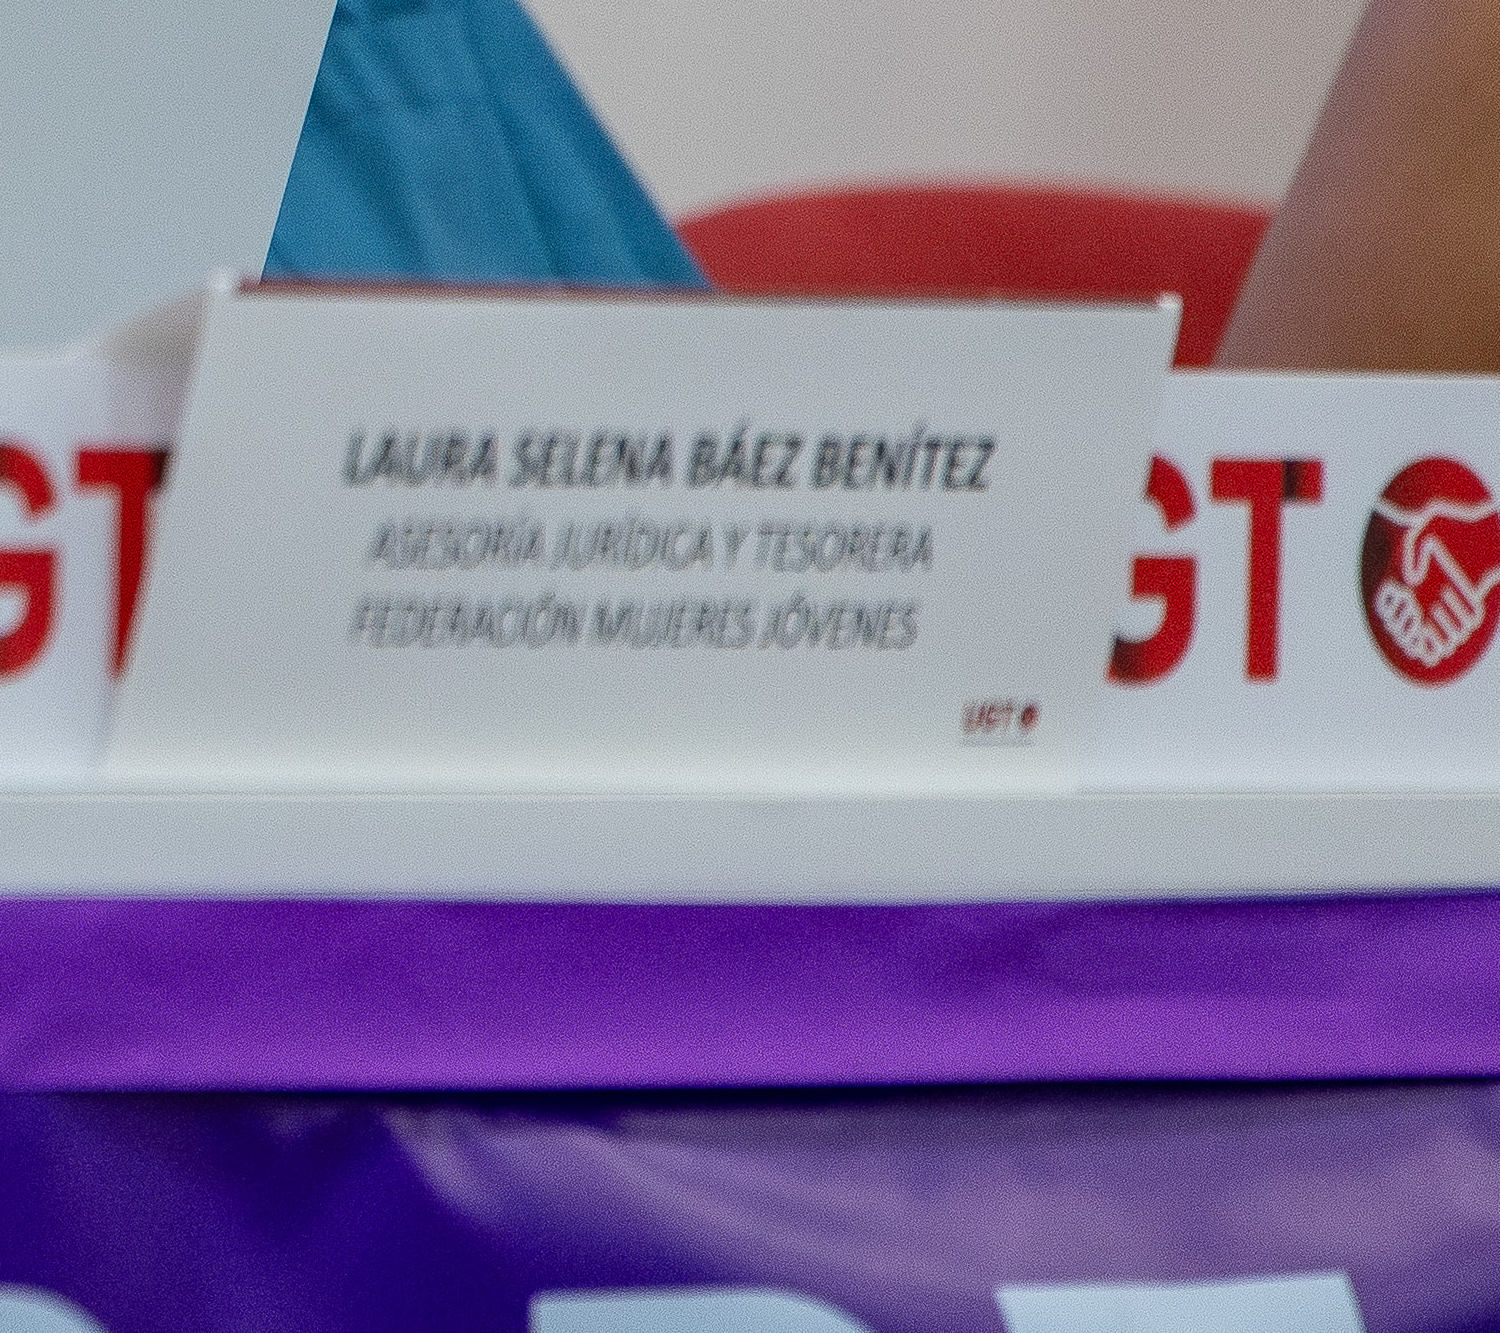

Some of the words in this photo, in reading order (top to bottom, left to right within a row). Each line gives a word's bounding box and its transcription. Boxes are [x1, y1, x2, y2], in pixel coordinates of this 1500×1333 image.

[343, 429, 498, 488] LAURA
[506, 429, 673, 488] SELENA
[688, 415, 803, 489] BÁEZ
[811, 418, 996, 491] BENÍTEZ
[368, 513, 544, 571] ASESORÍA
[551, 513, 712, 571] JURÍDICA
[720, 523, 750, 569] Y
[756, 521, 934, 573] TESORERA
[350, 591, 582, 649] FEDERACIÓN
[590, 597, 756, 649] MUJERES
[758, 593, 920, 651] JÓVENES
